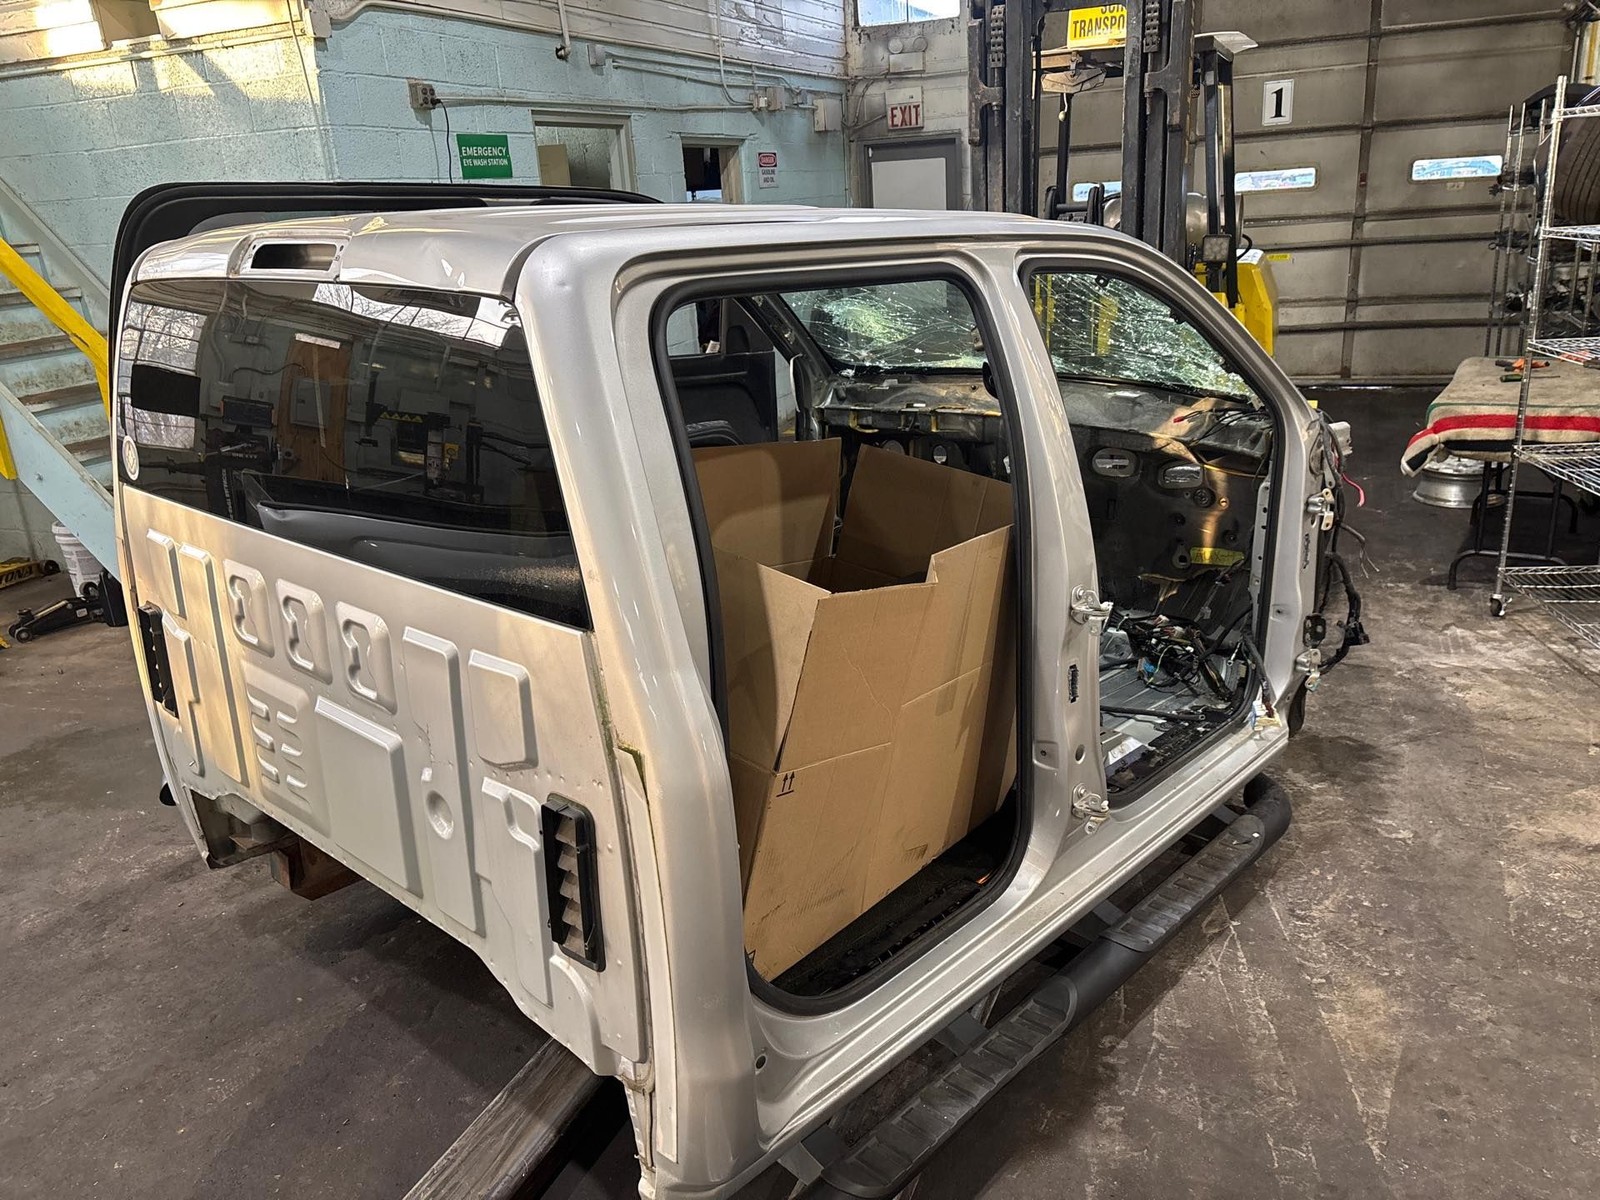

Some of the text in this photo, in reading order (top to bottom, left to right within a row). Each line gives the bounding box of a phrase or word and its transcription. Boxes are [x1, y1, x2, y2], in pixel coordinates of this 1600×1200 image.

[1270, 87, 1287, 119] 1
[891, 104, 920, 128] EXIT
[461, 146, 506, 156] EMERGENCY
[463, 158, 509, 167] EYE WASH STATION
